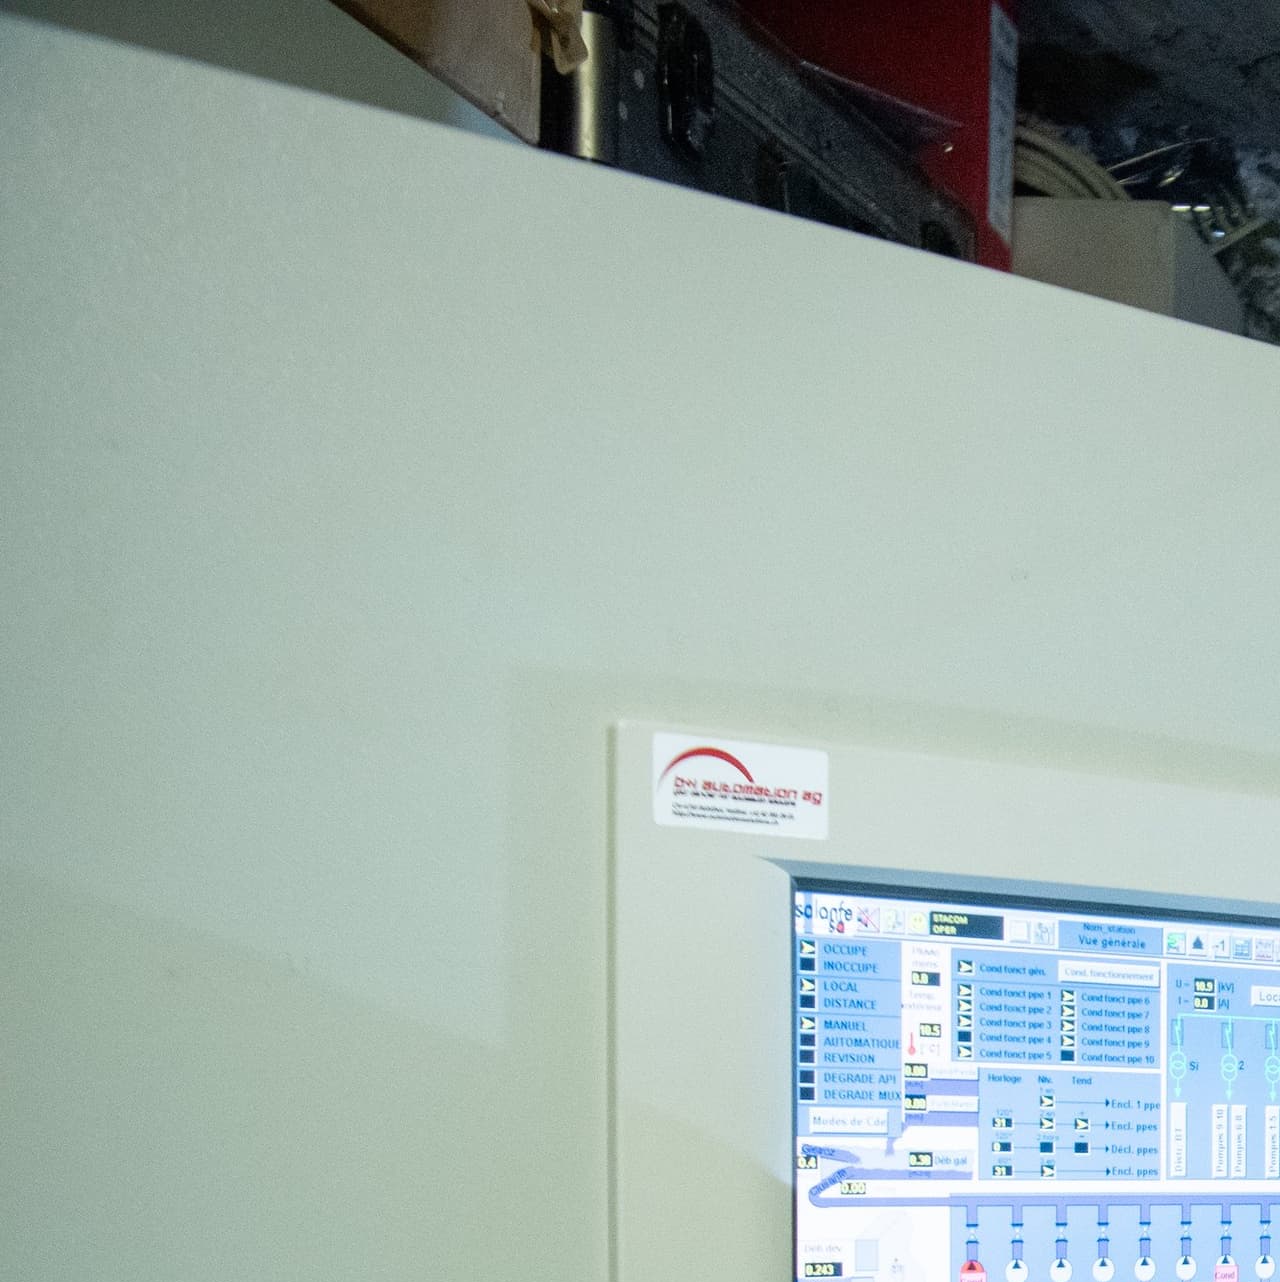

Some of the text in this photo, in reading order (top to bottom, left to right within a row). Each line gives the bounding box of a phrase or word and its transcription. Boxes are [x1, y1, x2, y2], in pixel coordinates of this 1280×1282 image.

[1078, 934, 1098, 945] Vue
[823, 944, 868, 956] OCCUPE
[823, 960, 880, 974] INOCCUPE
[823, 981, 859, 993] LOCAL
[823, 998, 877, 1010] DISTANCE
[823, 1020, 868, 1032] MANUEL
[823, 1037, 901, 1050] AUTOMATIQUE
[823, 1053, 876, 1064] REVISION
[823, 1072, 897, 1084] DEGRADE API
[823, 1089, 902, 1101] DEGRADE MUX
[1214, 1271, 1235, 1280] Cond
